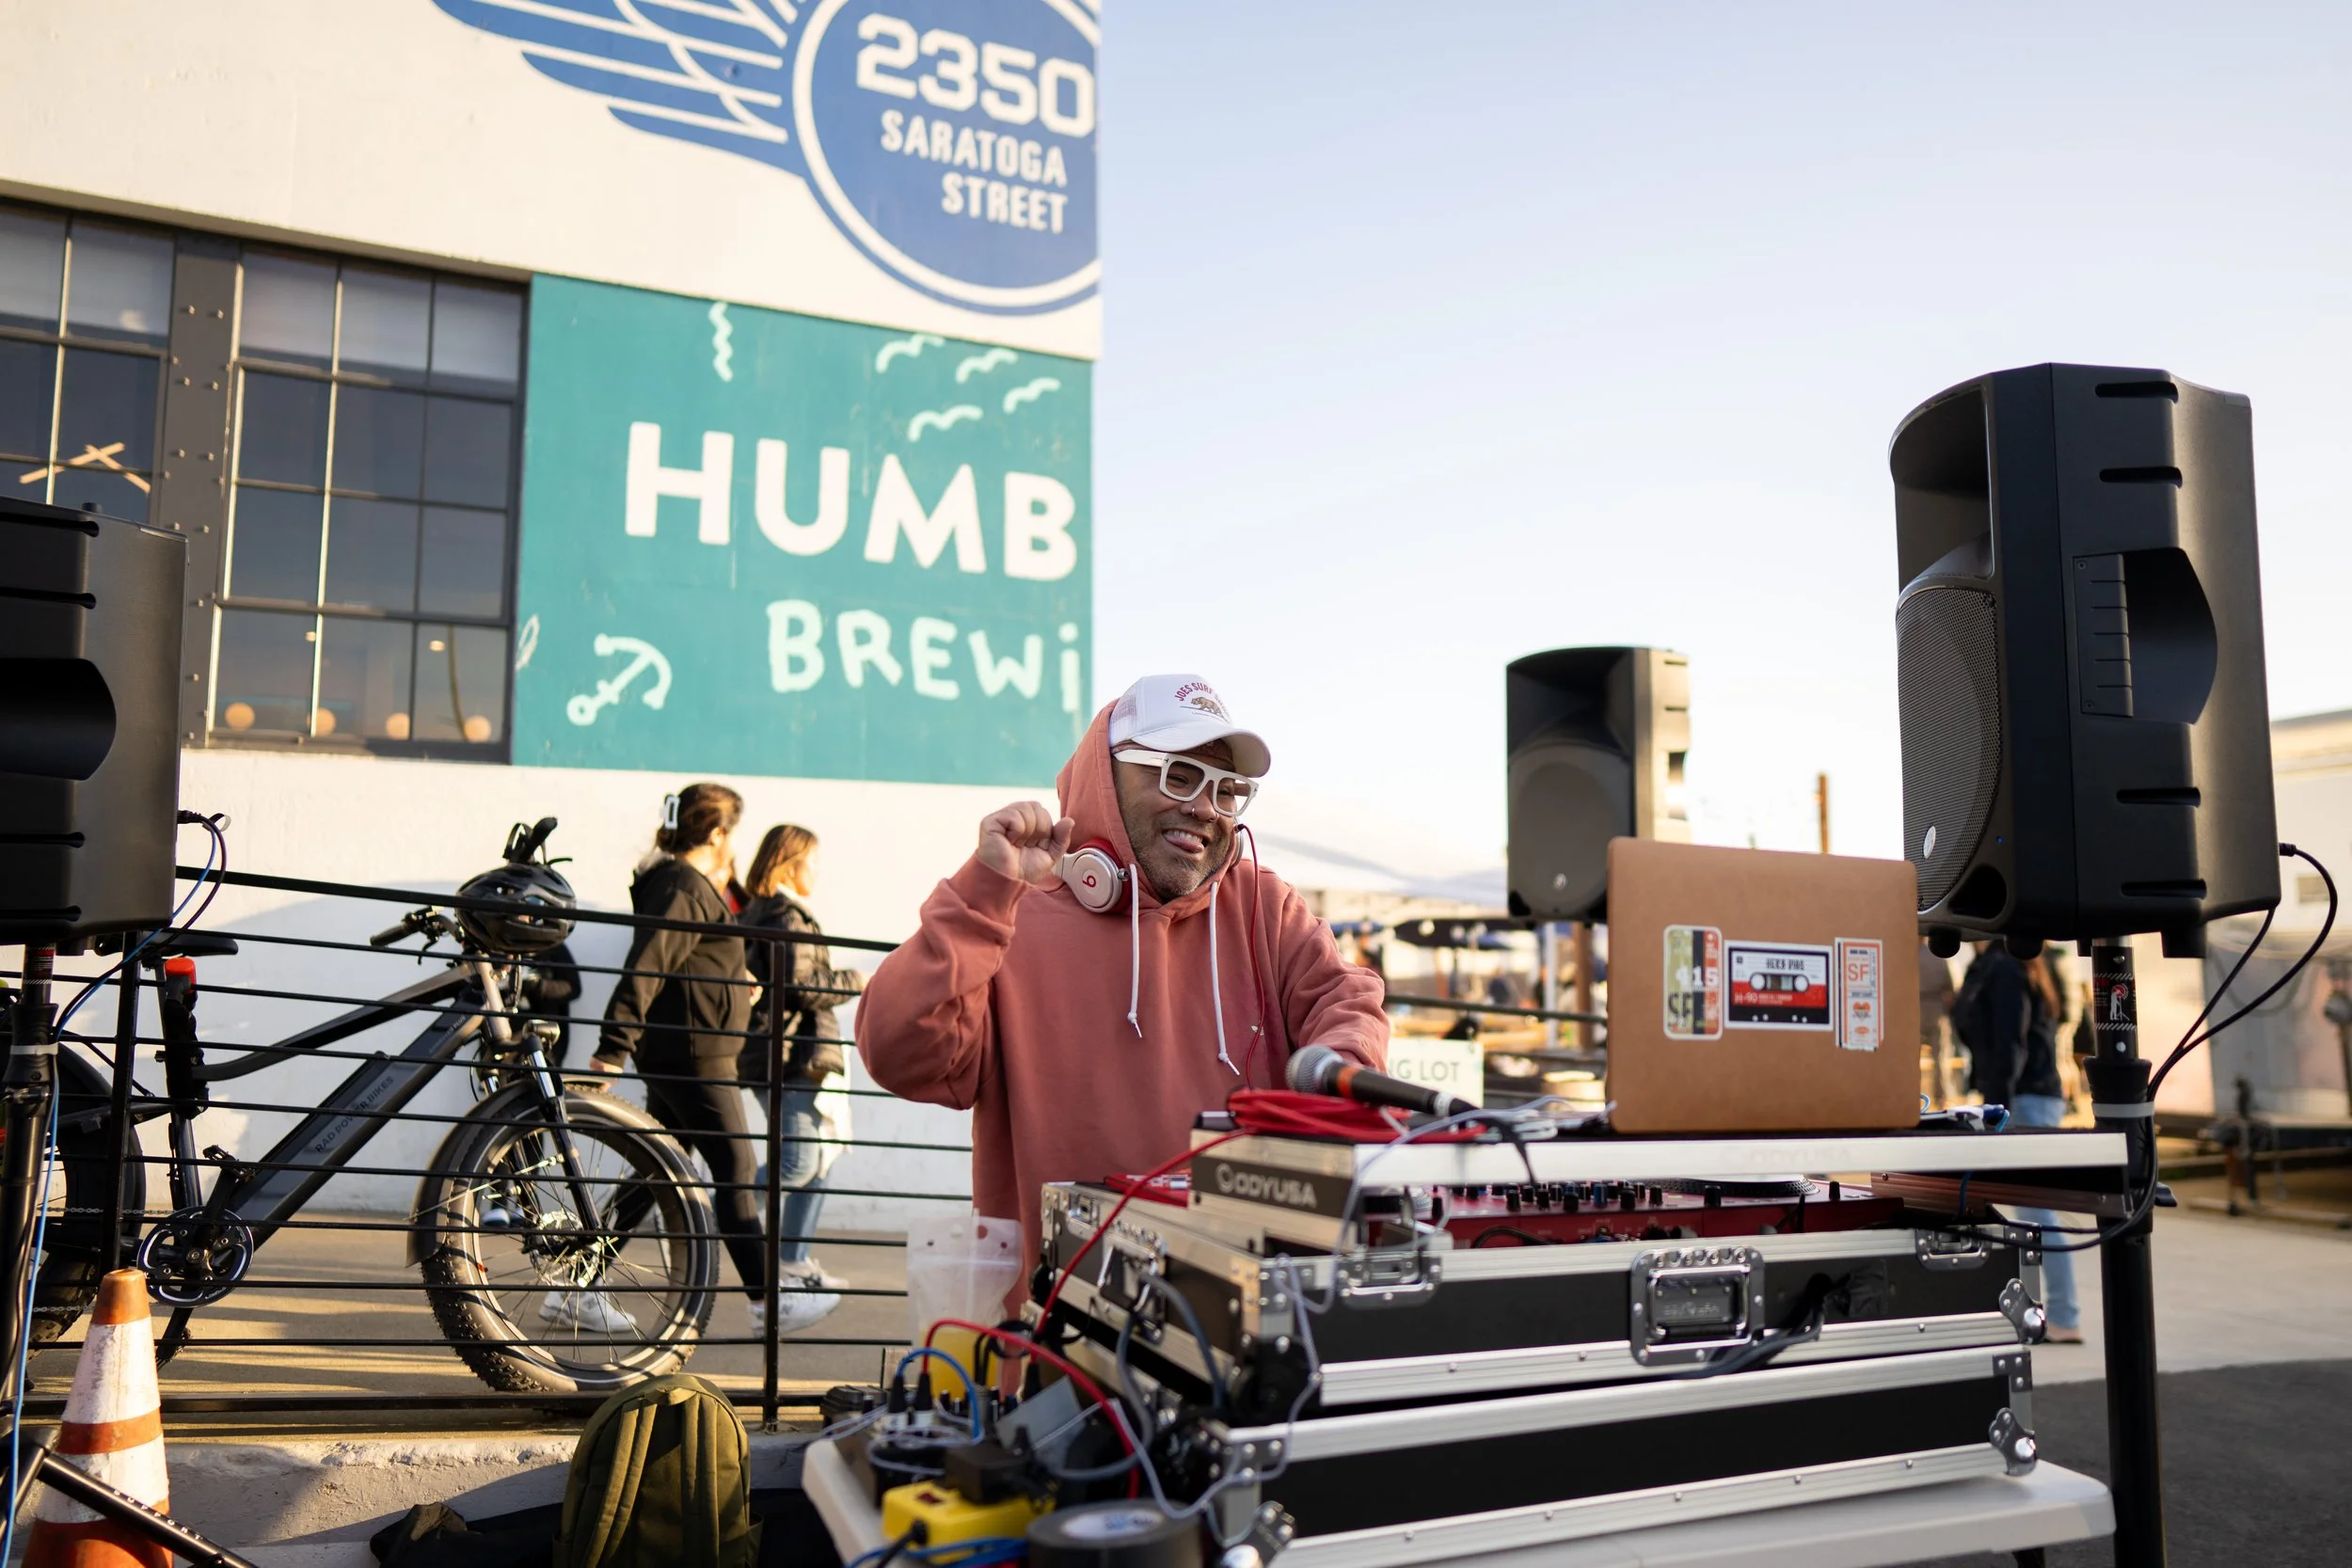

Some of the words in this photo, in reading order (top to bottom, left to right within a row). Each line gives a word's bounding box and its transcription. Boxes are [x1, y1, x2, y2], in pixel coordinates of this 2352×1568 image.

[856, 13, 1094, 137] 2350
[881, 109, 1067, 187] SARATOGA
[942, 172, 1068, 234] STREET
[626, 421, 1077, 580] HUMB
[1174, 684, 1193, 702] JOES
[1848, 962, 1869, 982] SF
[1420, 1060, 1460, 1082] LOT
[315, 1132, 336, 1153] RAD
[367, 1076, 394, 1103] BIKES
[113, 1489, 201, 1541] SUPPORT
